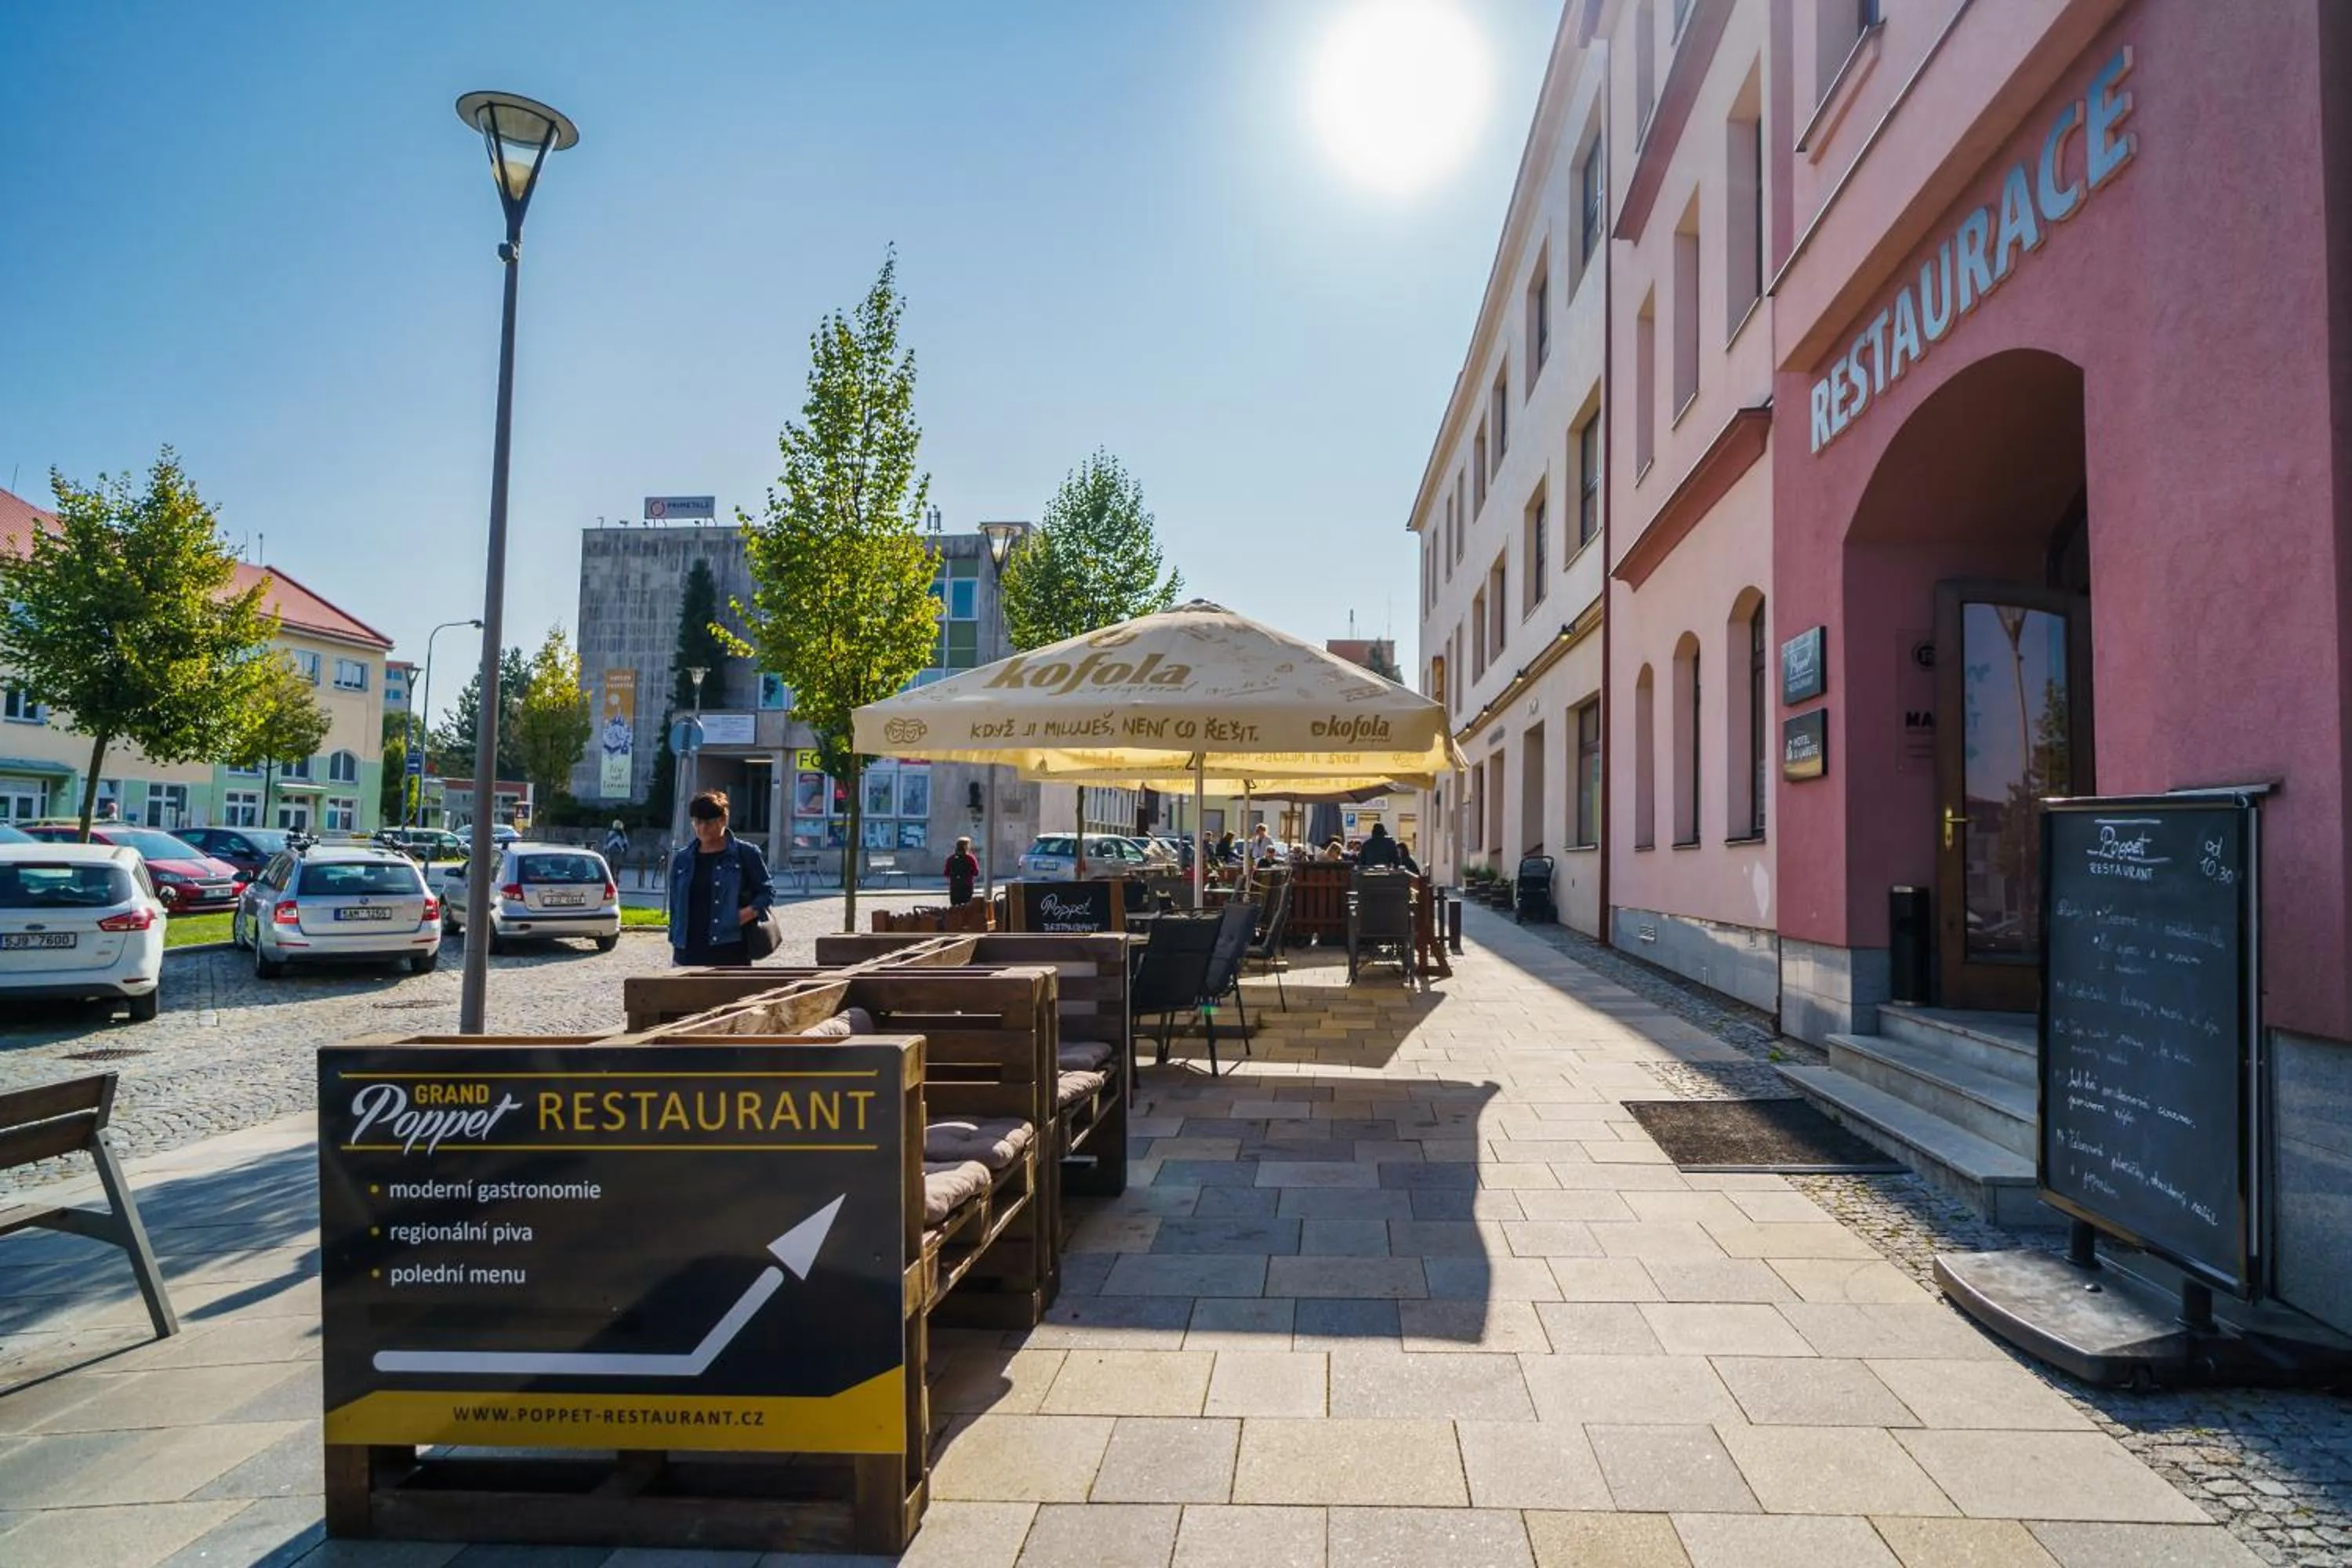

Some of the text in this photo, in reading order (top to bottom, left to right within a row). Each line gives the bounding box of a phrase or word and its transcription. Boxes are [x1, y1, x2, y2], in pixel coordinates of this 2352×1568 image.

[1810, 45, 2137, 454] RESTAURACE
[982, 652, 1193, 695] kofola
[970, 718, 1016, 739] KDYŽ
[1044, 710, 1115, 737] MILUJEŠ,
[1122, 717, 1170, 739] NENÍ
[1175, 720, 1196, 739] CO
[1204, 717, 1259, 742] ŘEŠIT.
[1327, 715, 1392, 743] kofola
[2089, 862, 2154, 880] RESTAURANT
[1040, 893, 1092, 920] Poppet
[39, 935, 70, 946] 7600
[415, 1084, 489, 1104] GRAND
[350, 1083, 876, 1156] Poppet RESTAURANT
[390, 1178, 602, 1202] moderní gastronomie
[390, 1221, 533, 1245] regionální piva
[391, 1263, 526, 1287] polední menu
[452, 1406, 765, 1426] WWW.POPPET-RESTAURANT.CZ
